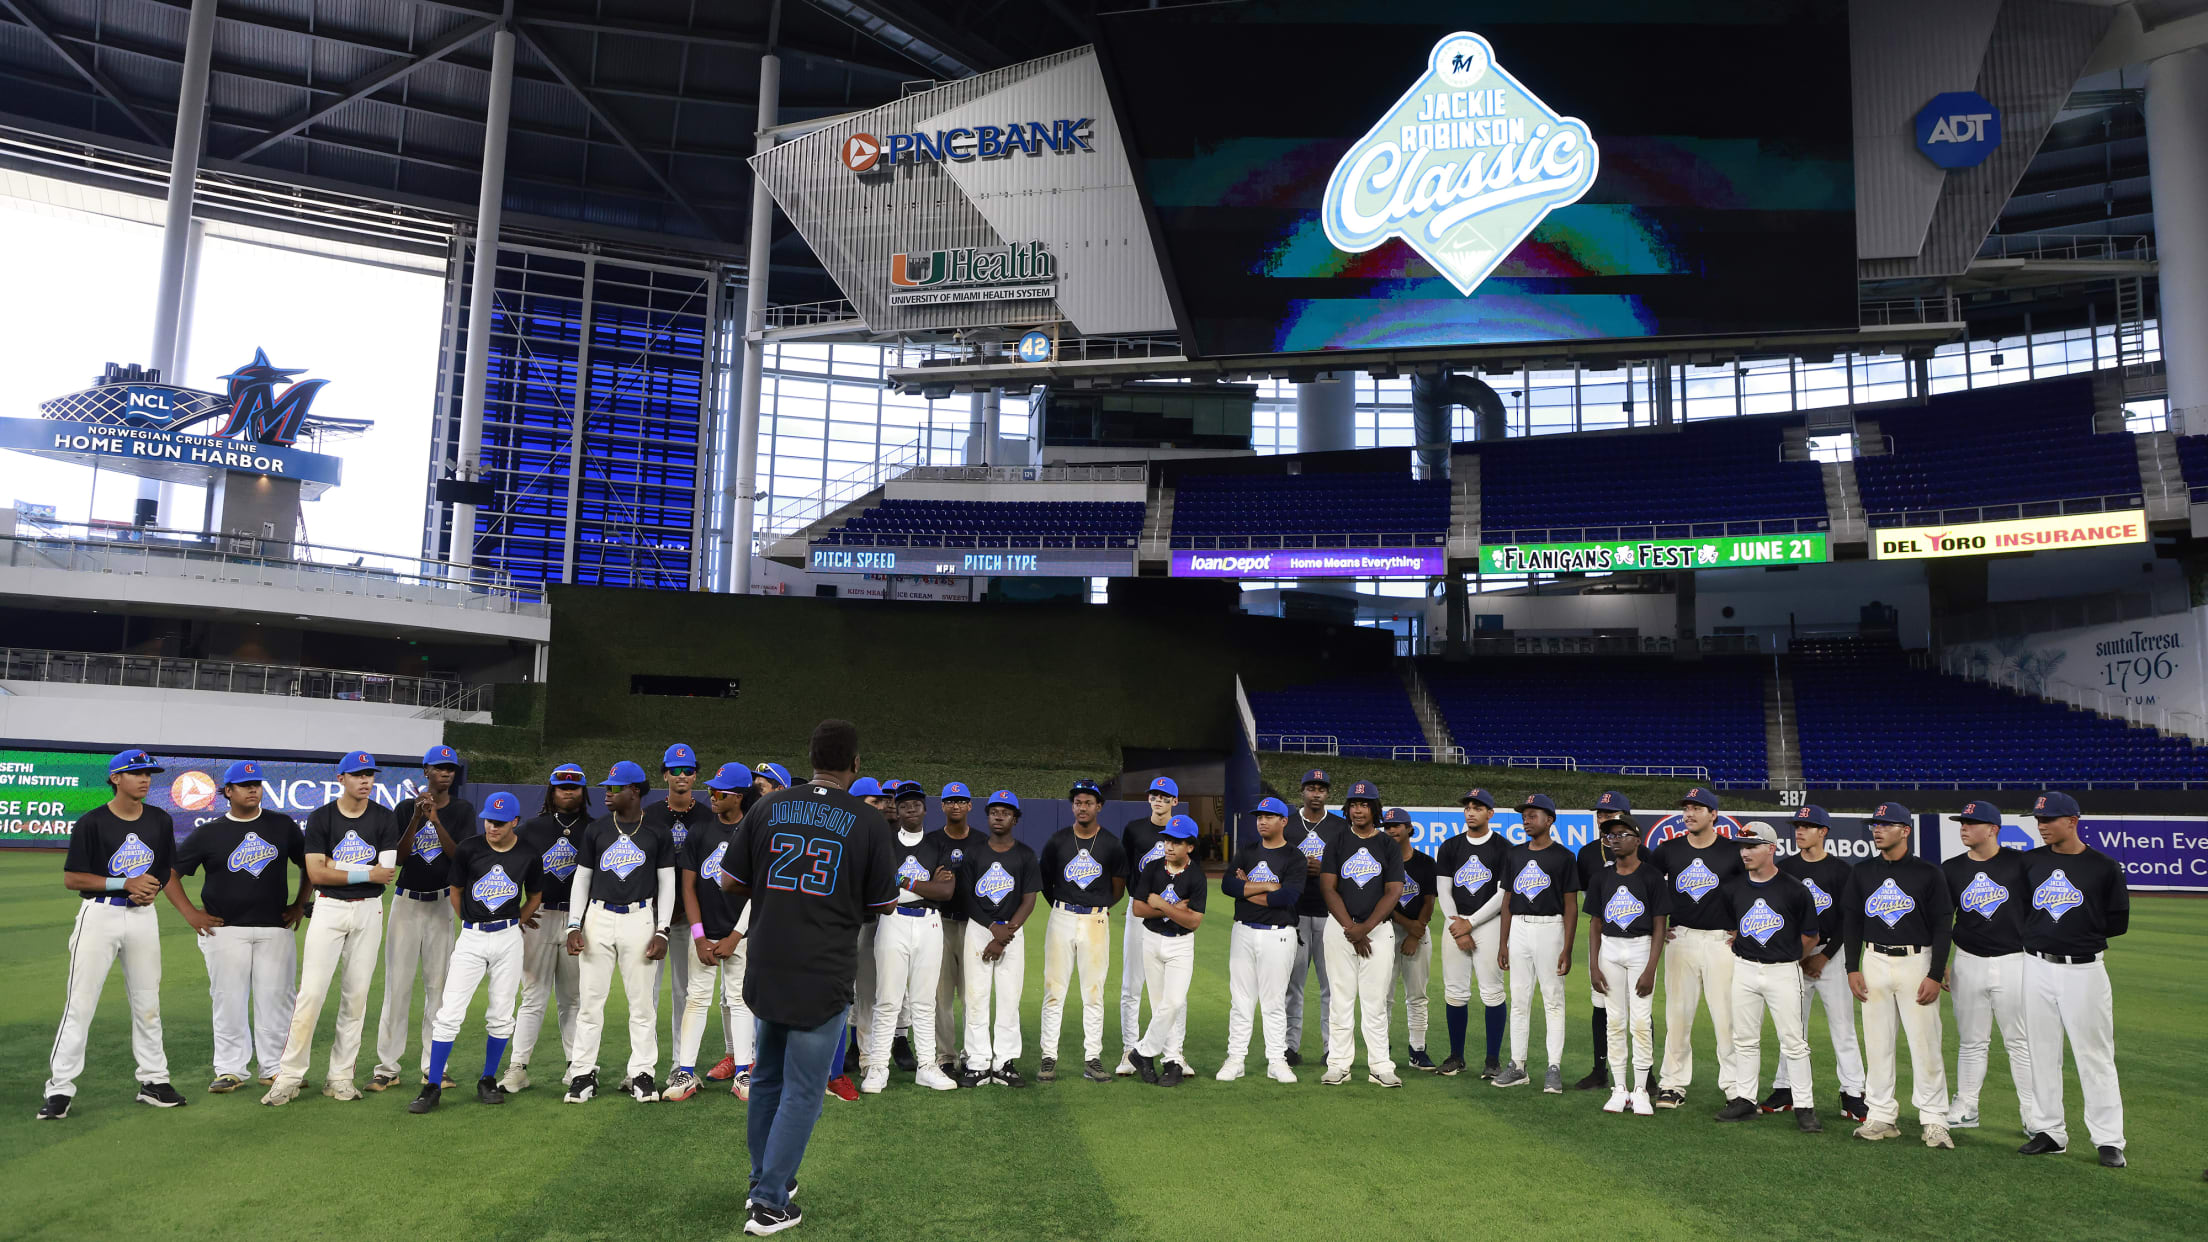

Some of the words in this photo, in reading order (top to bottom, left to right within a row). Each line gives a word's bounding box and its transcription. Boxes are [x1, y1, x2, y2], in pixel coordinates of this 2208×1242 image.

[1417, 89, 1506, 122] JACKIE
[1401, 117, 1525, 152] ROBINSON
[1927, 113, 1992, 144] ADT
[1338, 123, 1585, 238] Classic
[891, 294, 938, 305] UNIVERSITY
[940, 293, 951, 302] OF
[952, 292, 981, 301] MIAMI
[983, 290, 1015, 300] HEALTH
[1016, 288, 1050, 298] SYSTEM
[1021, 337, 1046, 356] 42
[129, 391, 170, 410] NCL
[88, 425, 170, 443] NORWEGIAN
[175, 435, 223, 448] CRUISE
[228, 442, 257, 453] LINE
[55, 434, 123, 454] HOME
[133, 441, 181, 460] RUN
[191, 446, 284, 473] HARBOR
[1883, 541, 1922, 554] DEL
[1995, 524, 2138, 547] INSURANCE
[814, 551, 851, 568] PITCH
[856, 552, 896, 569] SPEED
[1638, 544, 1695, 567] FEST
[1729, 540, 1783, 562] JUNE
[1789, 539, 1812, 559] 21
[936, 564, 956, 574] MPH
[964, 555, 1001, 571] PITCH
[1007, 555, 1037, 571] TYPE
[1191, 555, 1271, 573] loanDepot
[1290, 557, 1323, 569] Home
[1324, 557, 1361, 568] Means
[1361, 556, 1421, 571] Everything
[2104, 651, 2173, 693] 1796
[18, 775, 80, 787] INSTITUTE
[1780, 790, 1807, 806] 387
[27, 801, 64, 817] FOR
[768, 801, 857, 838] JOHNSON
[2098, 831, 2164, 849] When
[112, 852, 152, 873] Classic
[230, 847, 276, 868] Classic
[603, 850, 643, 870] Classic
[767, 832, 843, 896] 23
[1066, 864, 1101, 880] Classic
[1343, 861, 1380, 878] Classic
[1456, 870, 1490, 886] Classic
[473, 882, 516, 901] Classic
[978, 878, 1014, 895] Classic
[1516, 875, 1549, 891] Classic
[1677, 874, 1717, 892] Classic
[1867, 897, 1913, 915] Classic
[1963, 888, 2006, 909] Classic
[2035, 889, 2082, 909] Classic
[1607, 902, 1642, 920] Classic
[1742, 914, 1782, 935] Classic
